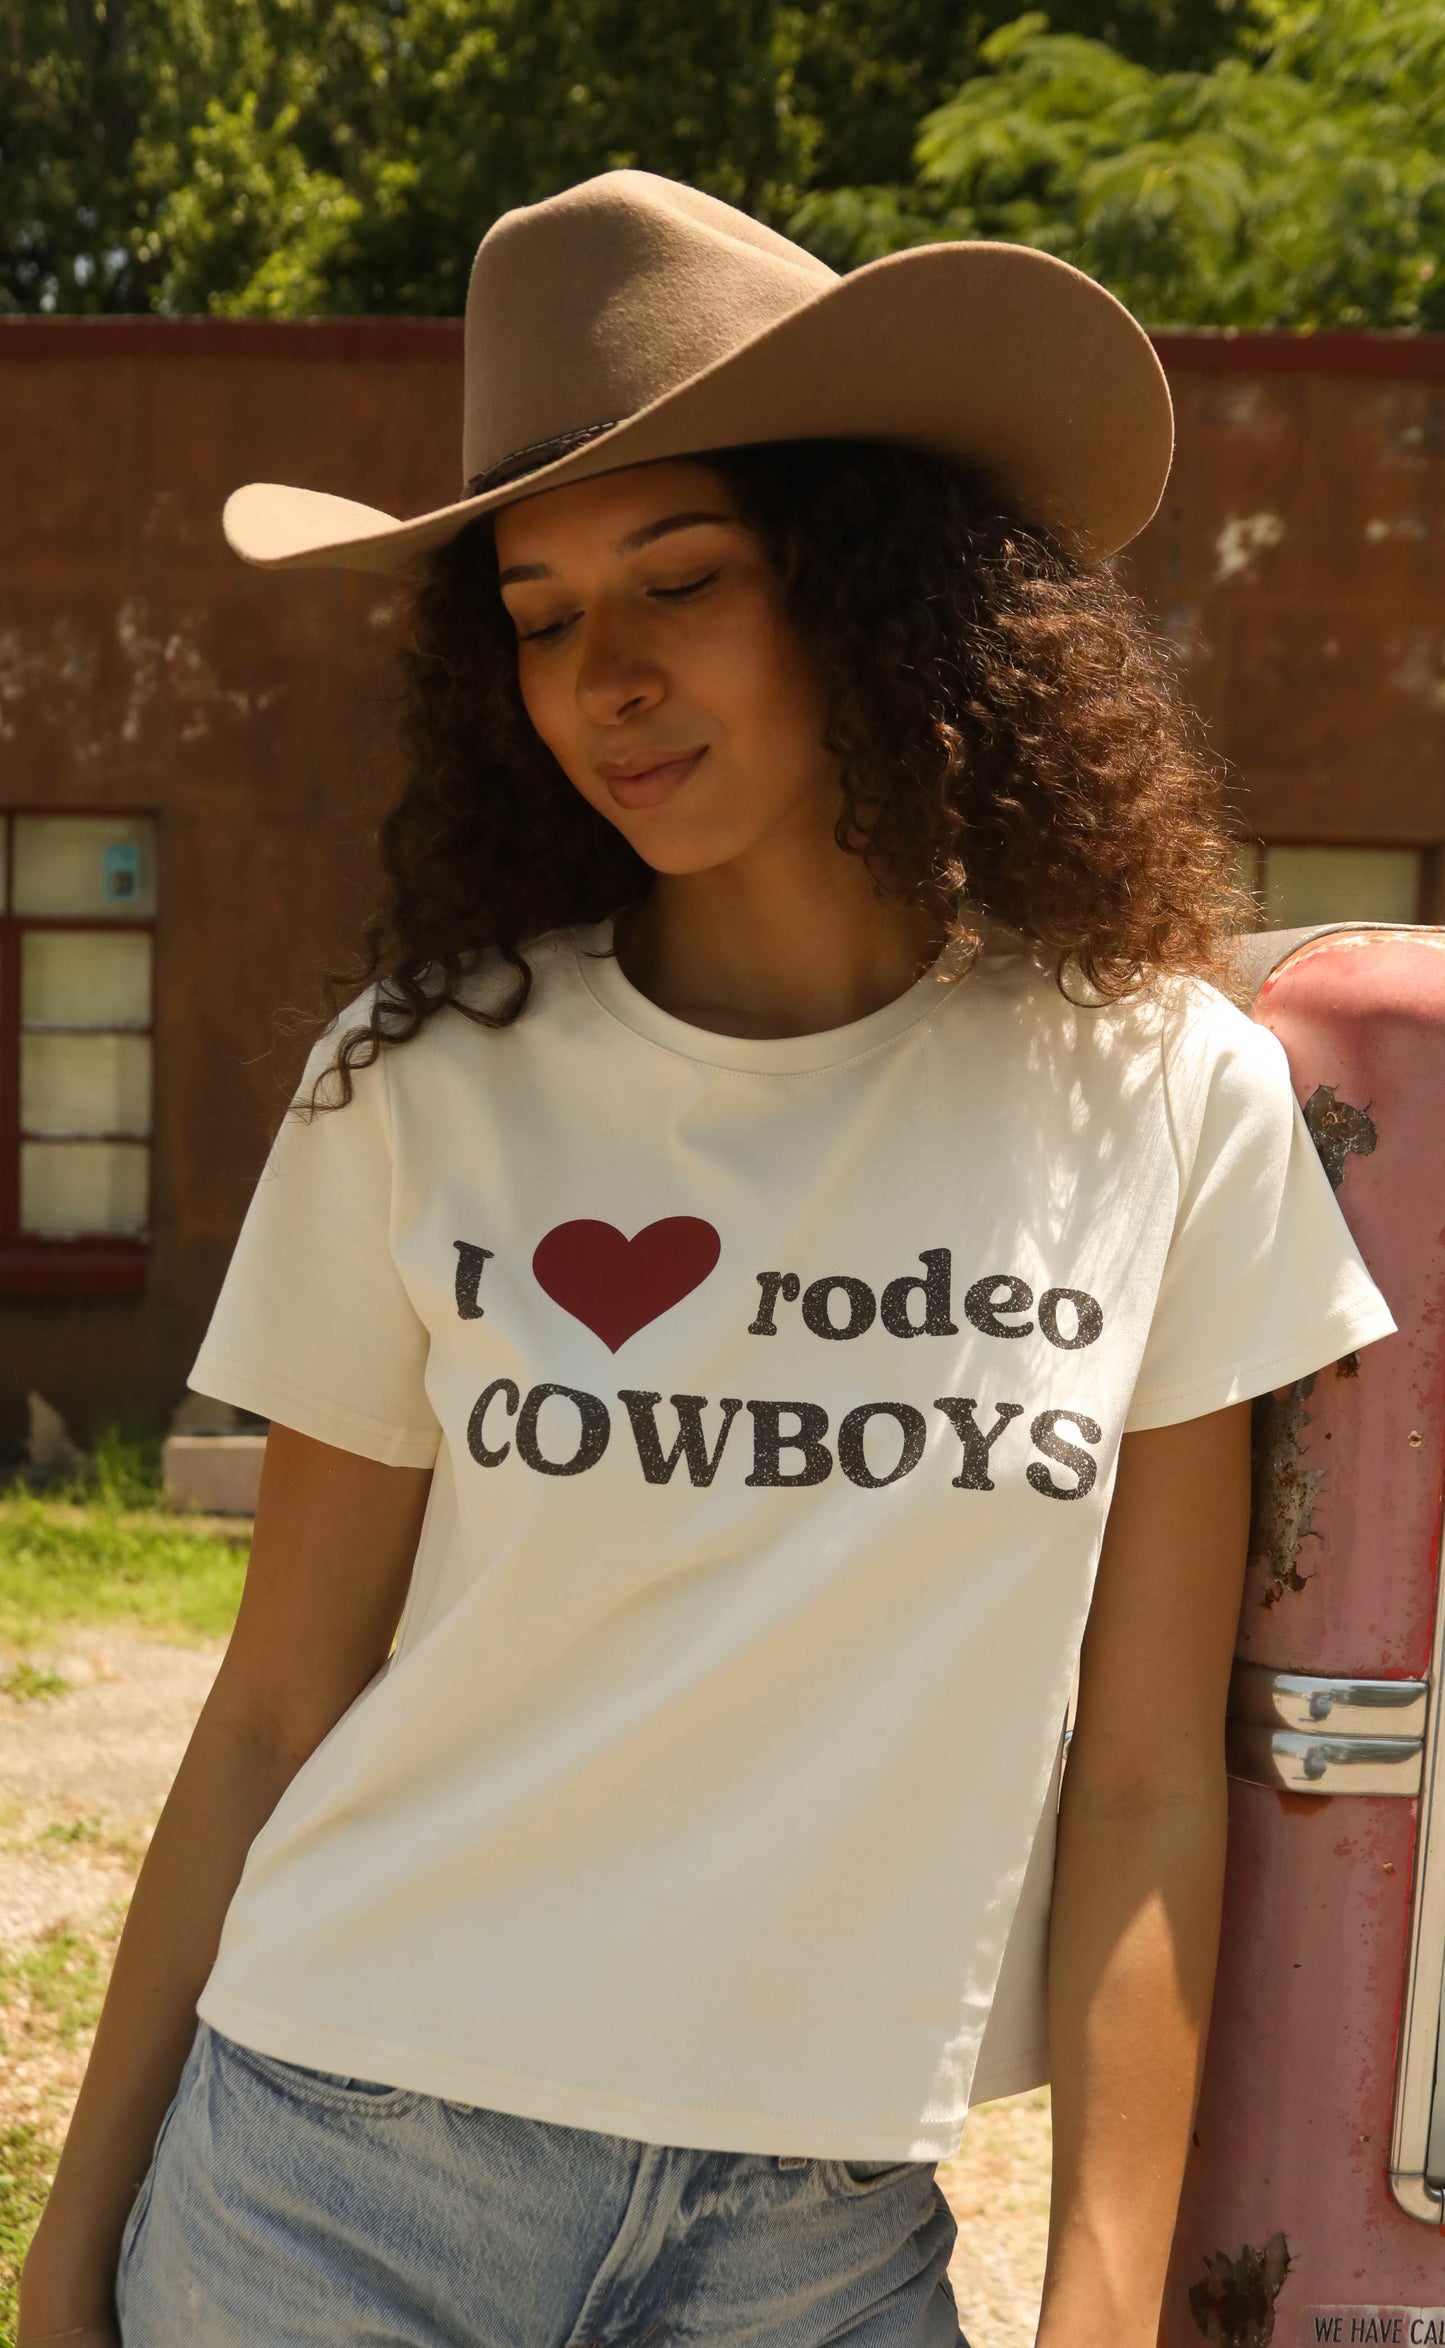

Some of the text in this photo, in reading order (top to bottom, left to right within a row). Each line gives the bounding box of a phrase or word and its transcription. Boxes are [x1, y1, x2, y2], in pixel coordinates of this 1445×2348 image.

[452, 1239, 1104, 1350] I rodeo
[466, 1377, 1102, 1501] COWBOYS
[1314, 2316, 1344, 2344] WE
[1350, 2317, 1403, 2344] HAVE
